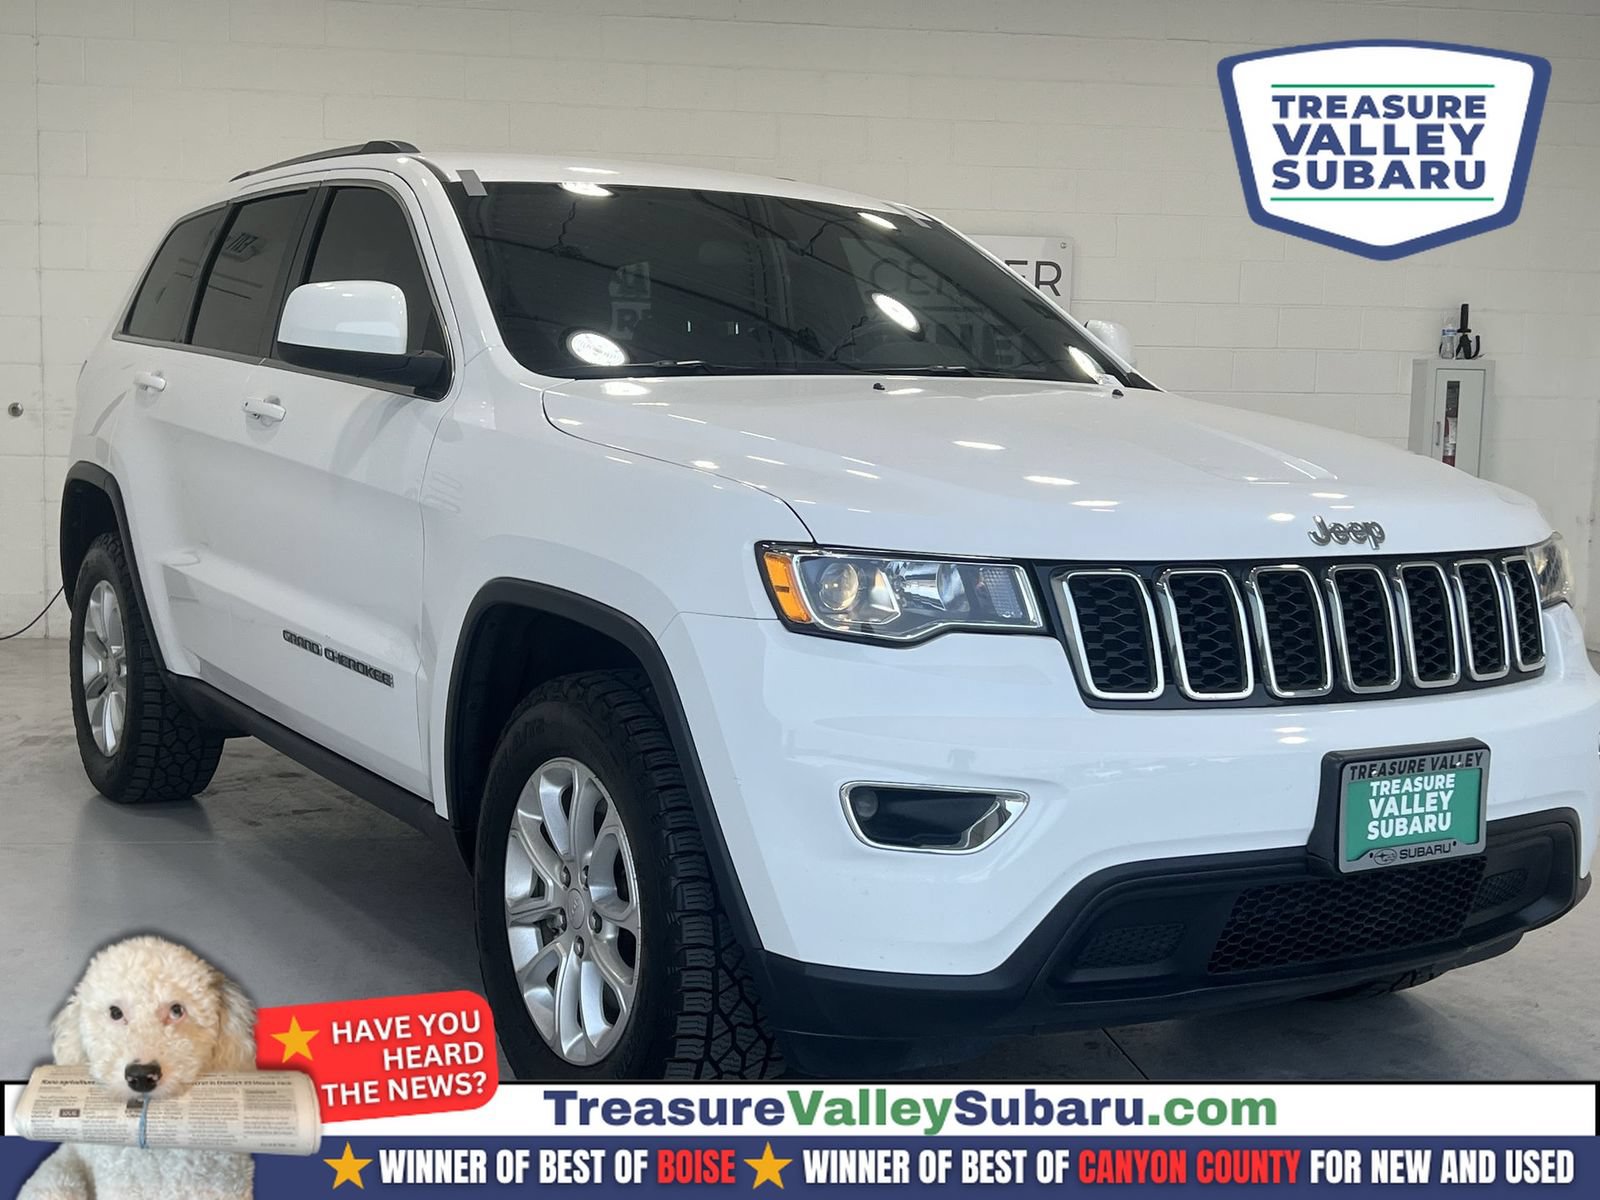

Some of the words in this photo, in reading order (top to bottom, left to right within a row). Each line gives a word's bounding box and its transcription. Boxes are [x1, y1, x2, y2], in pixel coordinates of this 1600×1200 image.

[1307, 515, 1386, 551] Jeep
[282, 629, 322, 656] GRAND
[324, 647, 394, 688] CHEROKEE
[1350, 758, 1426, 780] TREASURE
[1431, 751, 1484, 770] VALLEY
[1370, 773, 1456, 797] TREASURE
[1369, 789, 1454, 819] VALLEY
[1367, 811, 1452, 840] SUBARU
[1399, 843, 1452, 860] SUBARU
